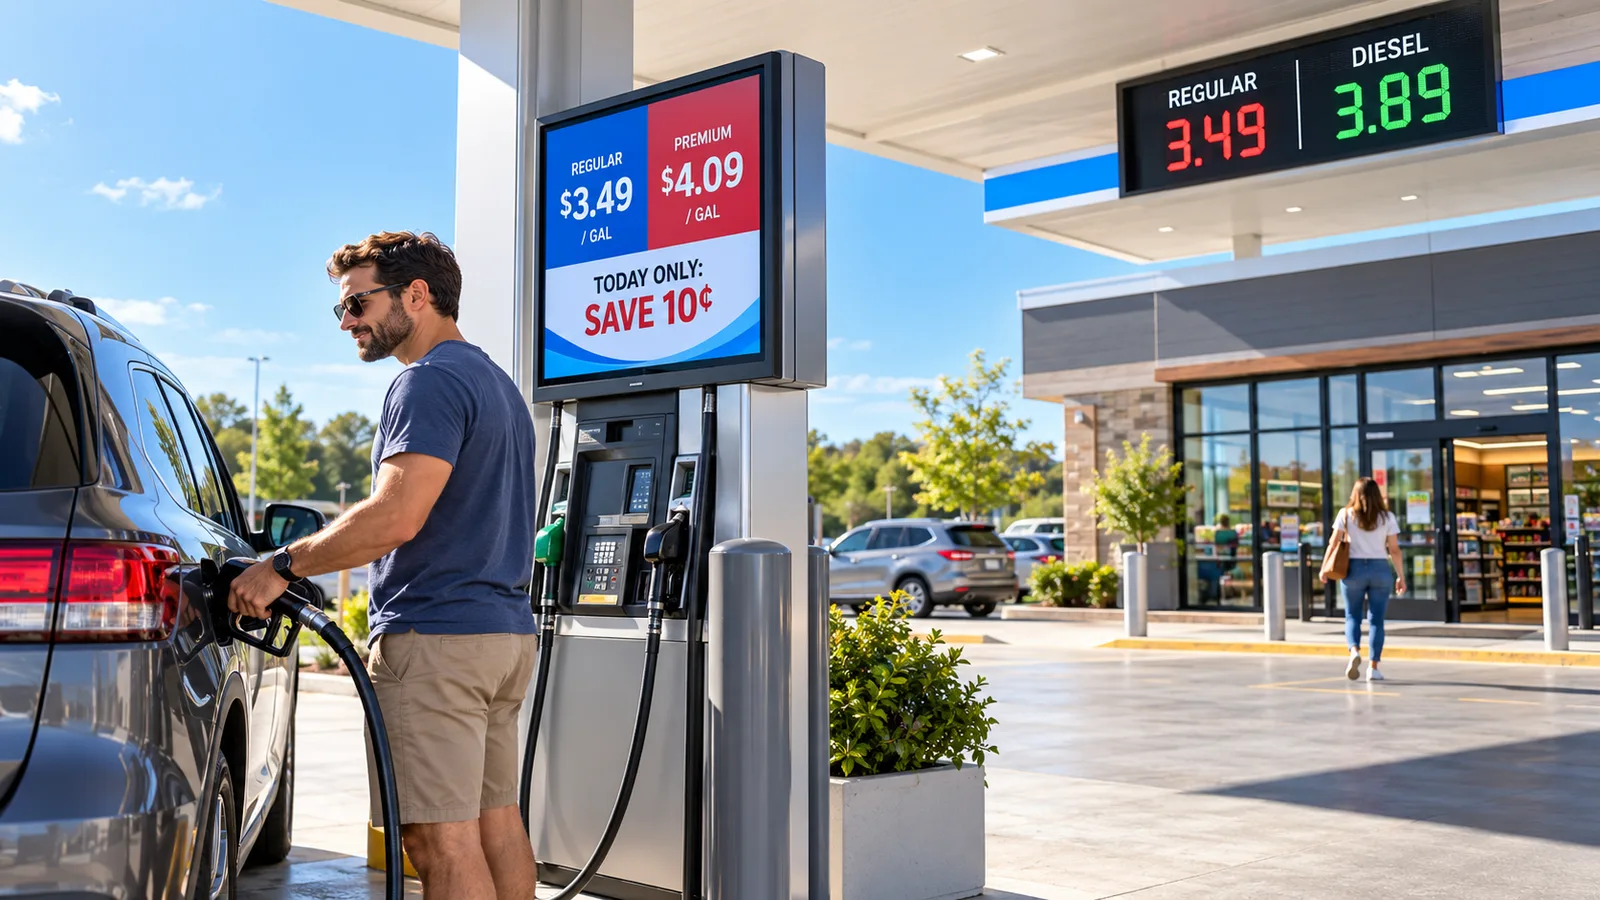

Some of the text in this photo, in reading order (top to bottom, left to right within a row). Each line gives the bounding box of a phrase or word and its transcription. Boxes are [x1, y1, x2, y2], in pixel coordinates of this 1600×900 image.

[1352, 32, 1429, 68] DIESEL
[1168, 71, 1258, 109] REGULAR
[1334, 63, 1451, 140] 3.89
[674, 124, 732, 151] PREMIUM
[1166, 102, 1266, 172] 3.49
[571, 151, 623, 176] REGULAR
[661, 151, 744, 198] $4.09
[560, 176, 633, 220] $3.49
[695, 204, 720, 222] GAL
[589, 226, 613, 243] GAL
[594, 258, 703, 295] TODAY ONLY:
[585, 283, 713, 337] SAVE 10¢
